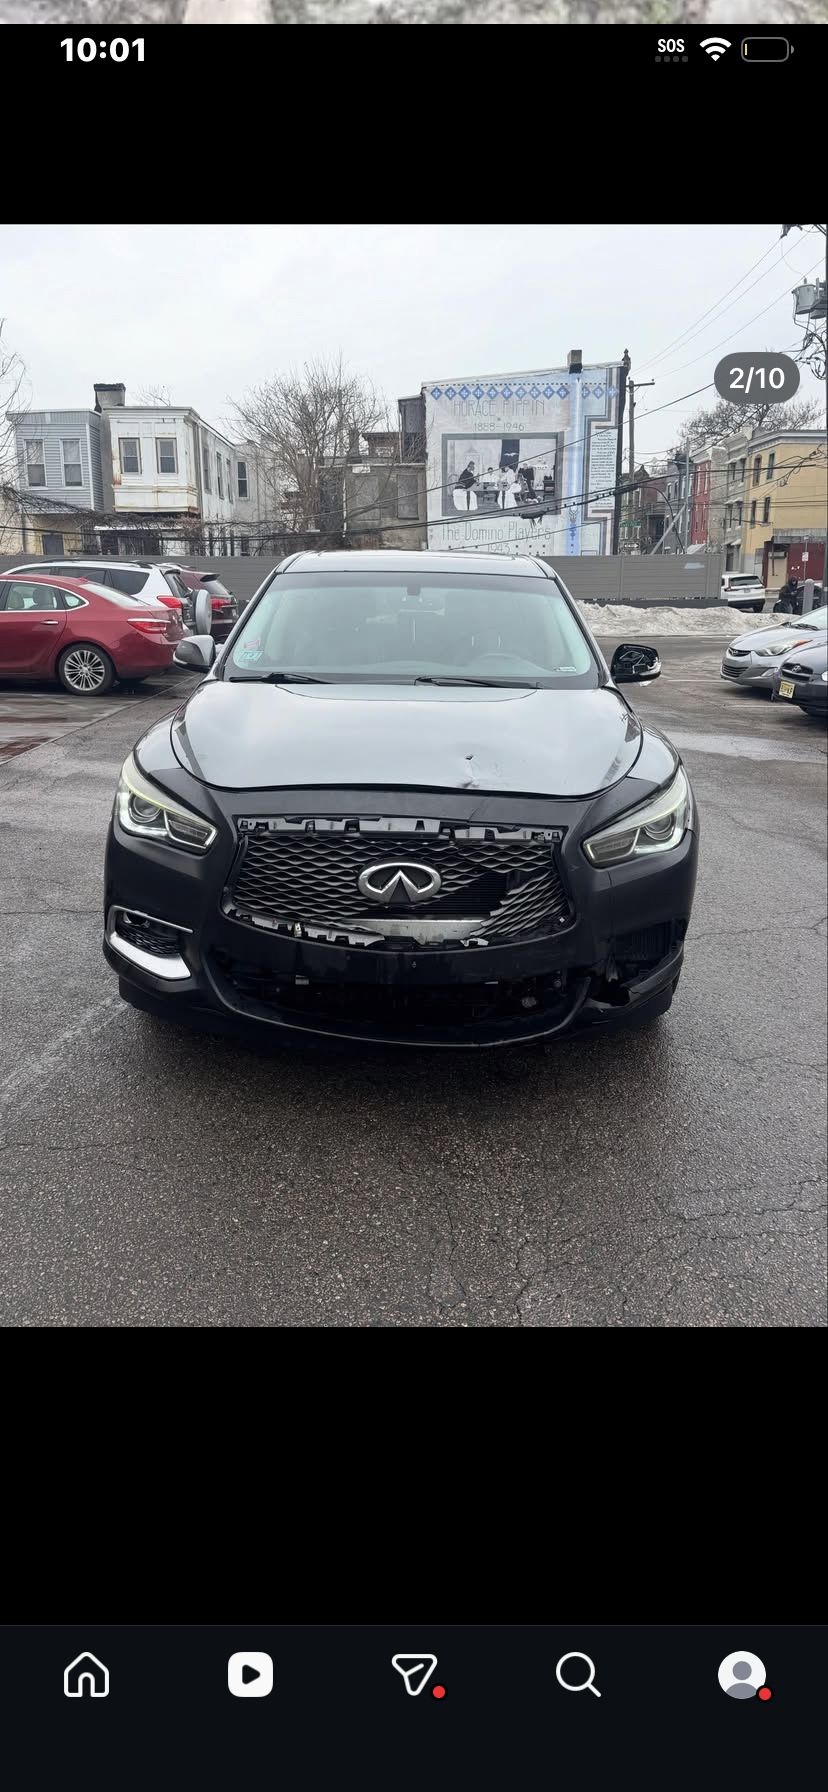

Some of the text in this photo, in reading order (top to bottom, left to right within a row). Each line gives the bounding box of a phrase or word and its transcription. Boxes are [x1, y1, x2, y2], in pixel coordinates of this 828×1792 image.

[453, 399, 545, 417] HORACE PIPPIN
[442, 520, 551, 542] The Domino Players
[487, 542, 511, 555] 1943
